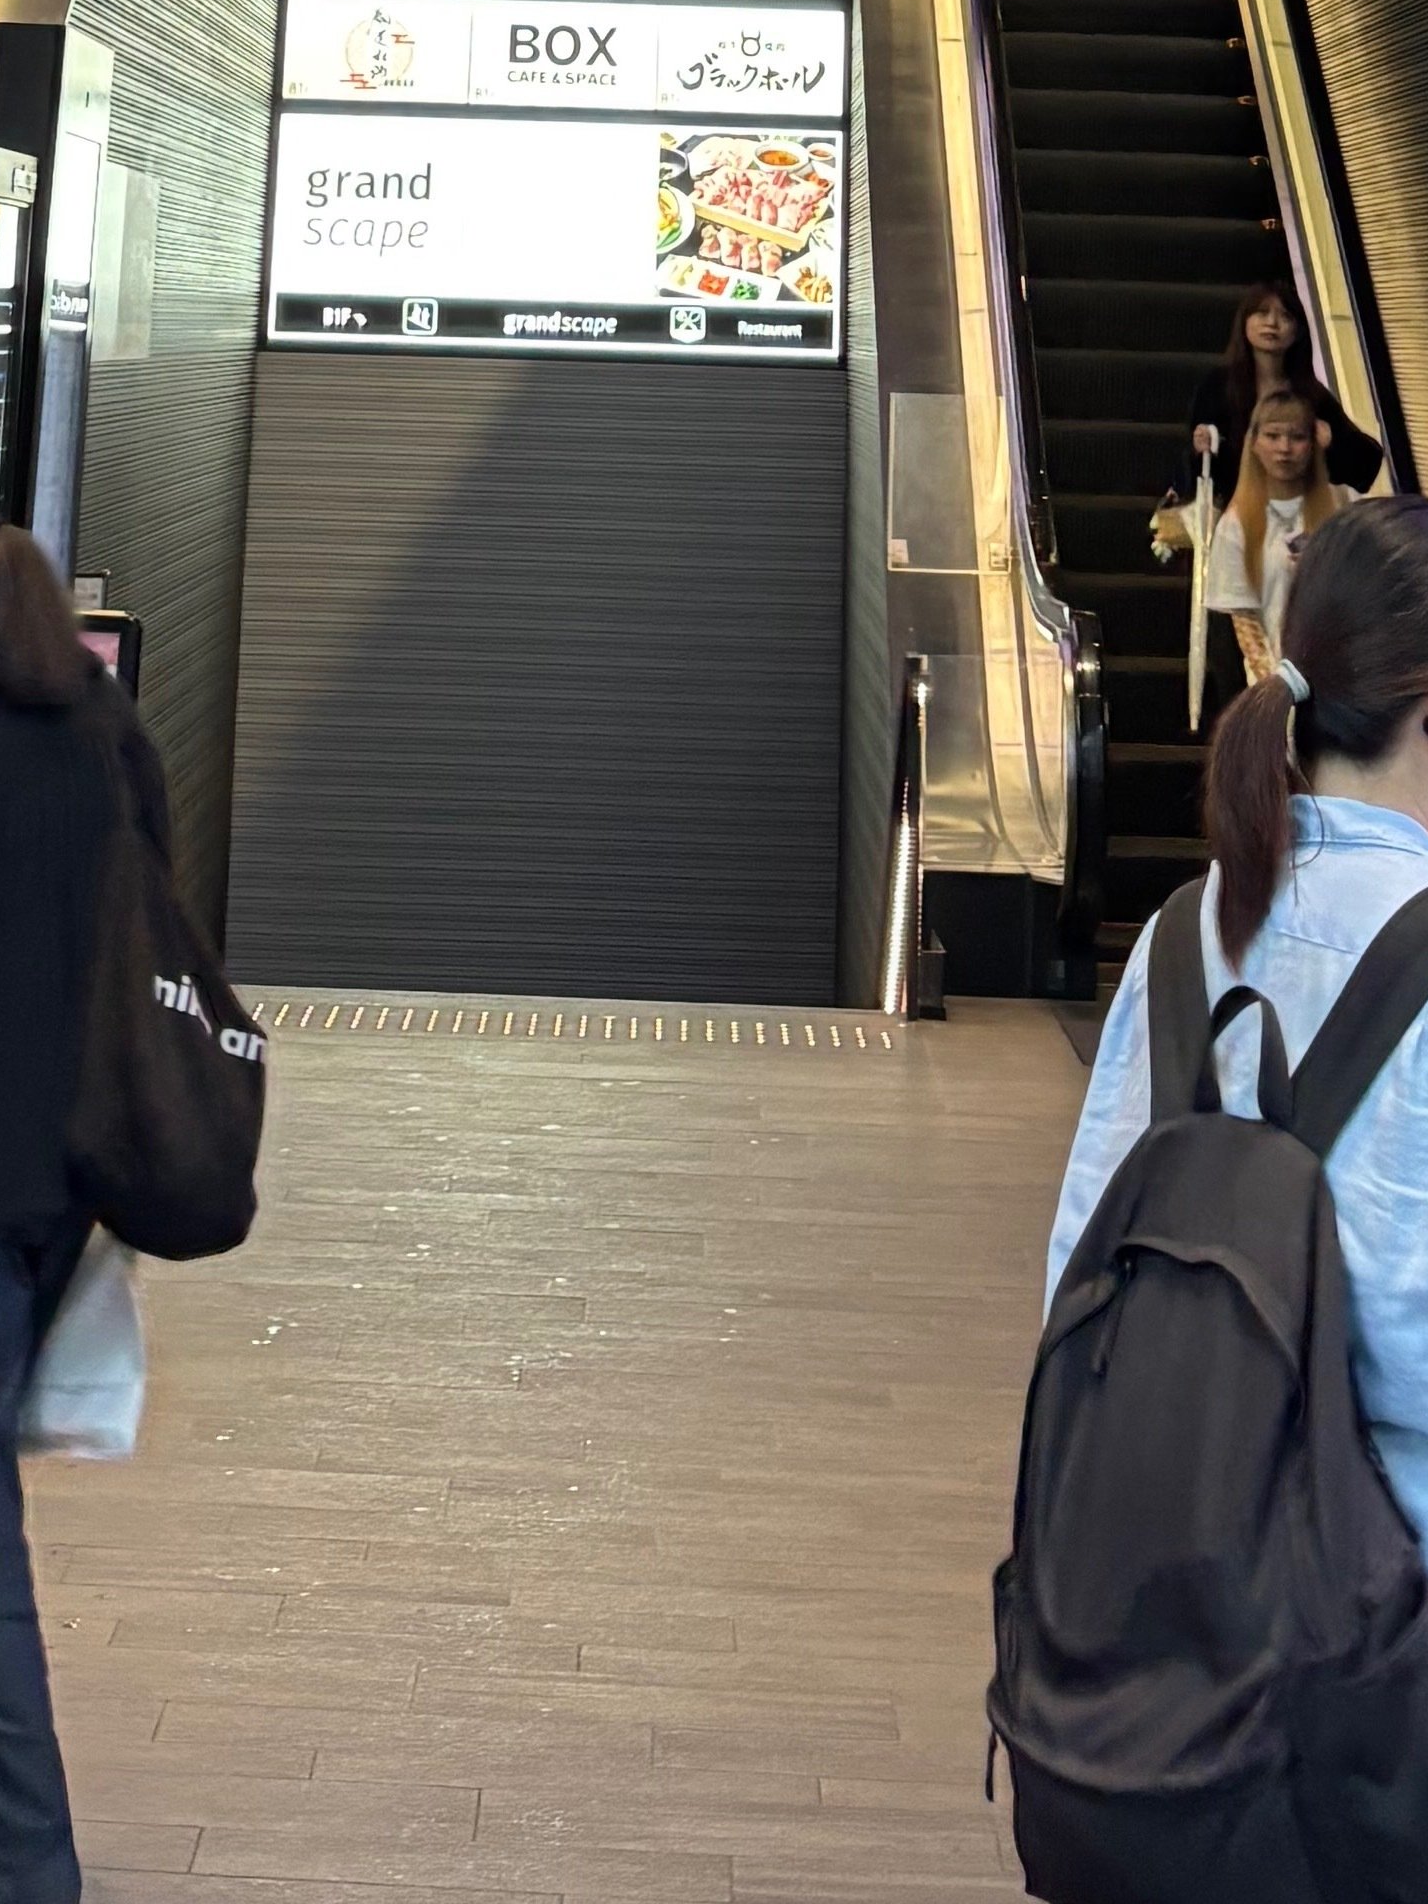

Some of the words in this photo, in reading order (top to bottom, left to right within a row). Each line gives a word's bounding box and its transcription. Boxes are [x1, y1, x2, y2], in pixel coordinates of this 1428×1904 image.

[509, 24, 617, 67] BOX
[507, 70, 546, 84] CAFE
[565, 72, 617, 86] SPACE
[306, 162, 433, 208] grand
[303, 215, 430, 258] scape
[503, 311, 618, 337] grandscape
